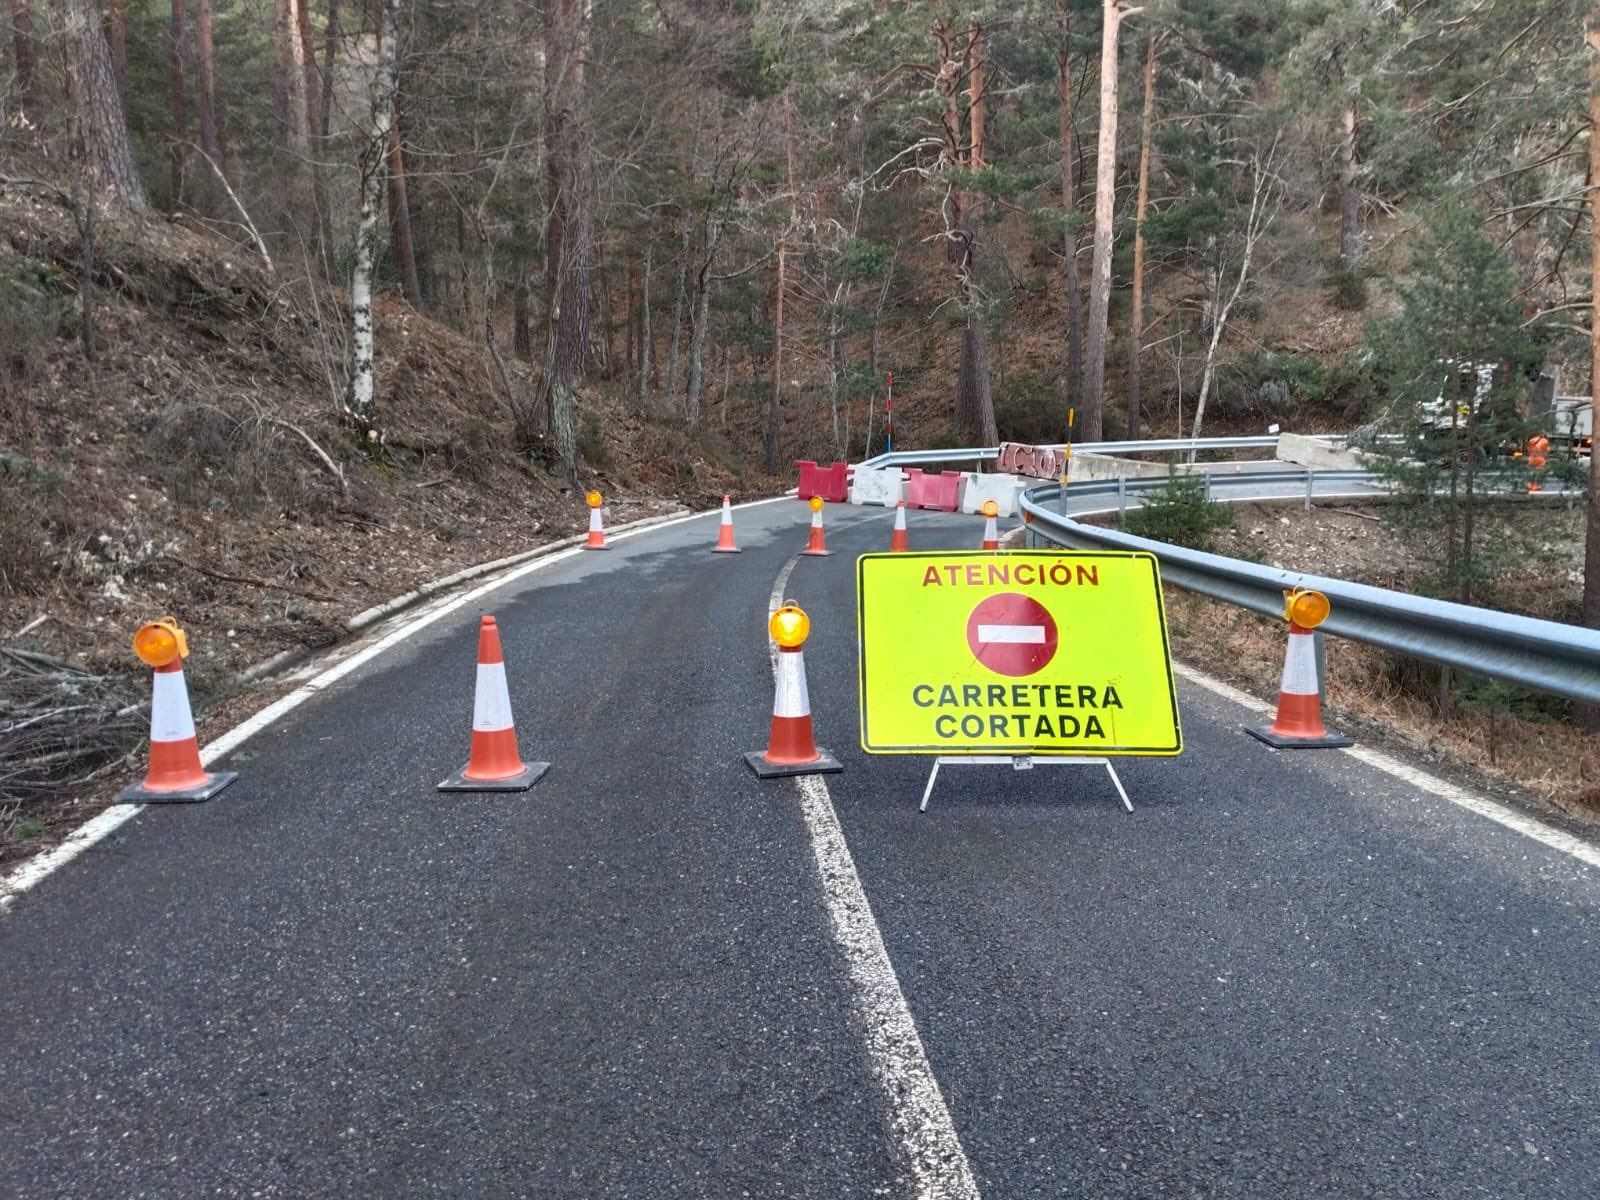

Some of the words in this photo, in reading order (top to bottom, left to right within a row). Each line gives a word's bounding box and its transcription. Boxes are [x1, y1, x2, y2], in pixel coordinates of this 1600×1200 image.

[922, 560, 1099, 587] ATENCIÓN
[912, 684, 1123, 709] CARRETERA
[935, 714, 1106, 738] CORTADA
